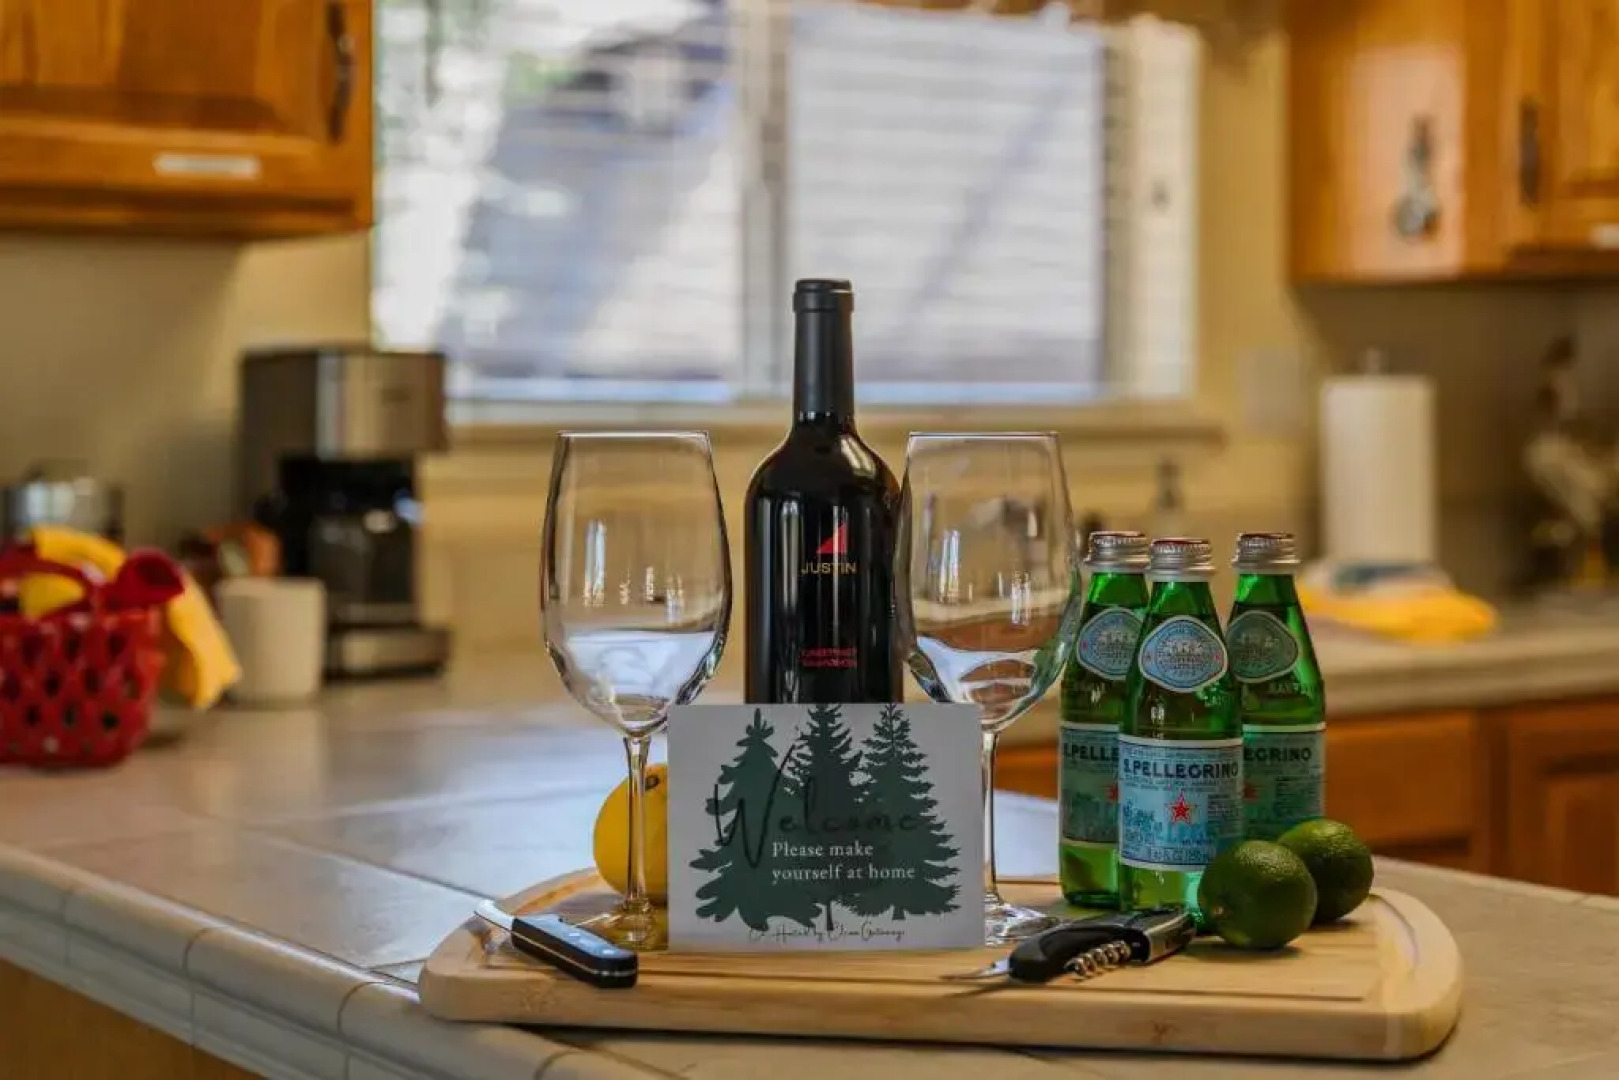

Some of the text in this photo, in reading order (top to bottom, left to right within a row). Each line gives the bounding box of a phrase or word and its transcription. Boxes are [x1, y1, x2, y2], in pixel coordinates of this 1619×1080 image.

[801, 562, 857, 576] JUSTIN
[1244, 747, 1312, 762] EGRINO
[1123, 758, 1239, 779] S.PELLEGRINO
[714, 743, 920, 868] Welcome
[772, 840, 874, 857] Please make
[772, 863, 916, 885] yourself at home
